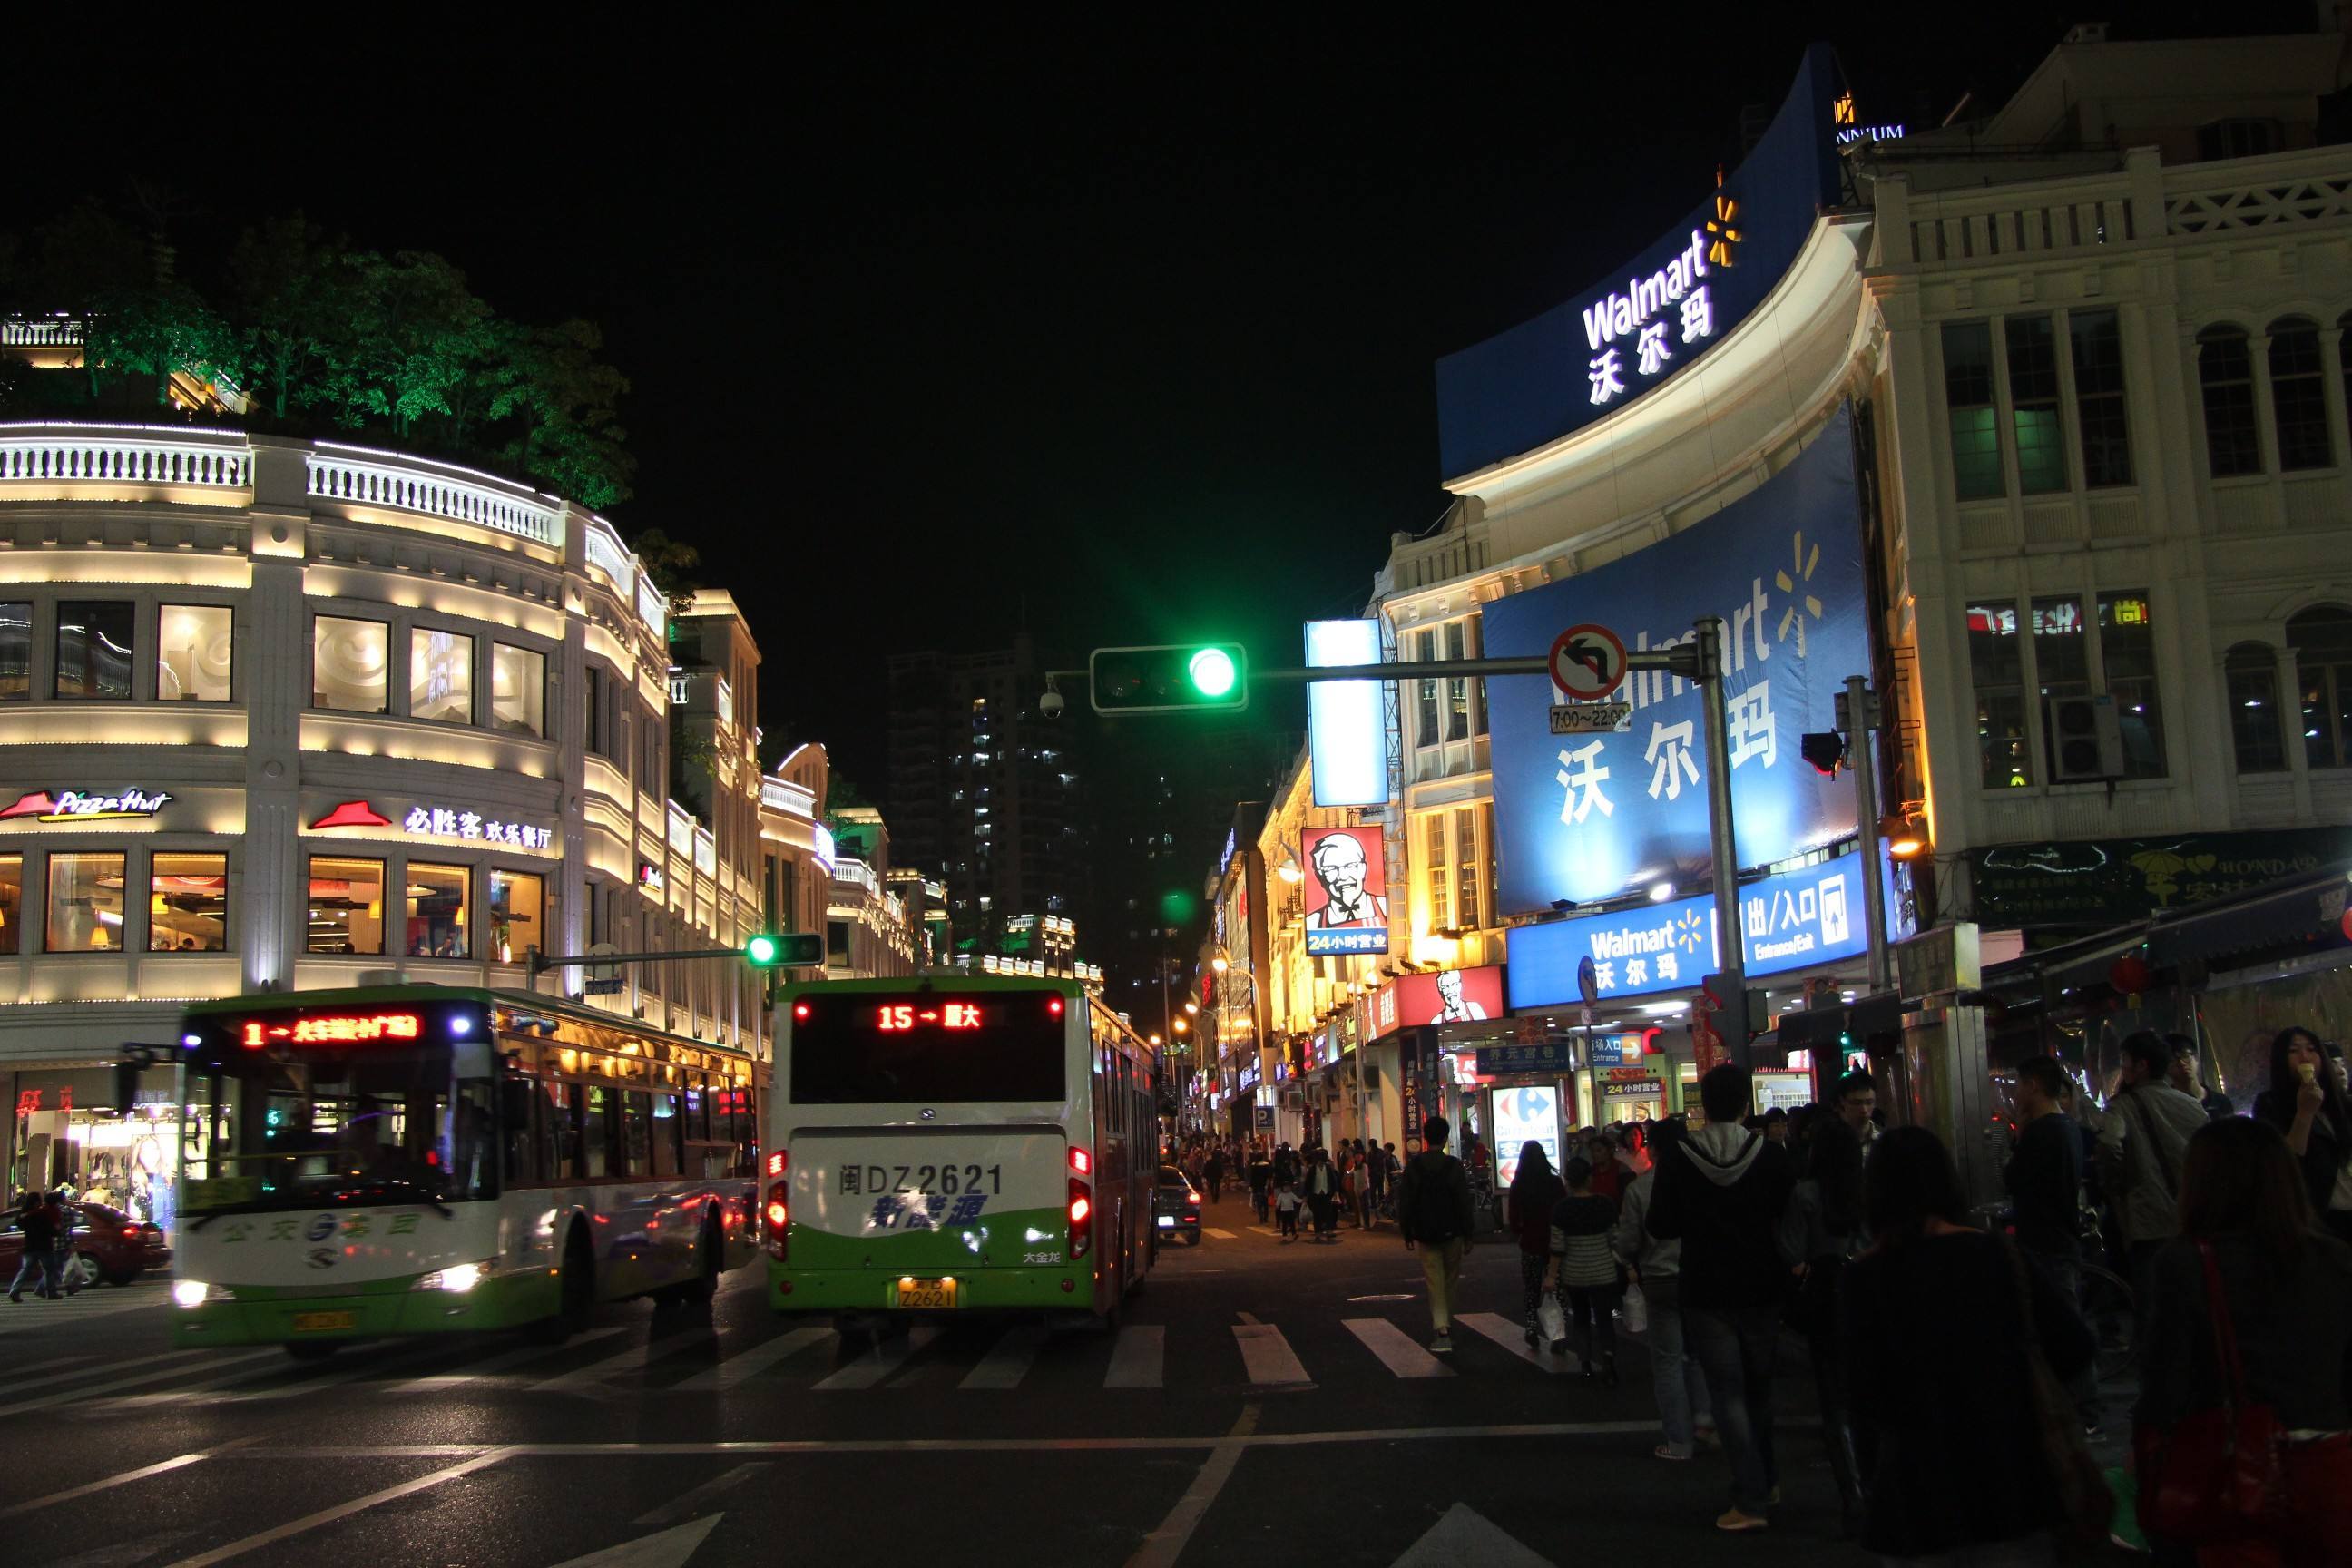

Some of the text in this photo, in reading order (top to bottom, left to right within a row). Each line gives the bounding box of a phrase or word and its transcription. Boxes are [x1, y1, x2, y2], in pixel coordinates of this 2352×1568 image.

[1583, 229, 1708, 351] Walmart
[1588, 285, 1713, 406] 沃尔玛
[1555, 679, 1777, 826] 沃尔玛
[54, 789, 172, 816] Pizza Hut
[405, 806, 553, 849] 必胜客 欢乐餐厅
[1747, 887, 1817, 939] 出/入口
[1308, 933, 1387, 952] 24小时营业
[1590, 919, 1676, 961] Walmart
[1592, 952, 1679, 991] 沃尔玛
[879, 1006, 913, 1029] 15
[244, 1023, 264, 1046] 1
[1592, 1053, 1619, 1063] Entrance
[1607, 1082, 1661, 1094] 24小时营业
[839, 1164, 1002, 1196] 闽DZ2621
[1023, 1251, 1062, 1264] 大金龙
[901, 1290, 952, 1308] Z2621
